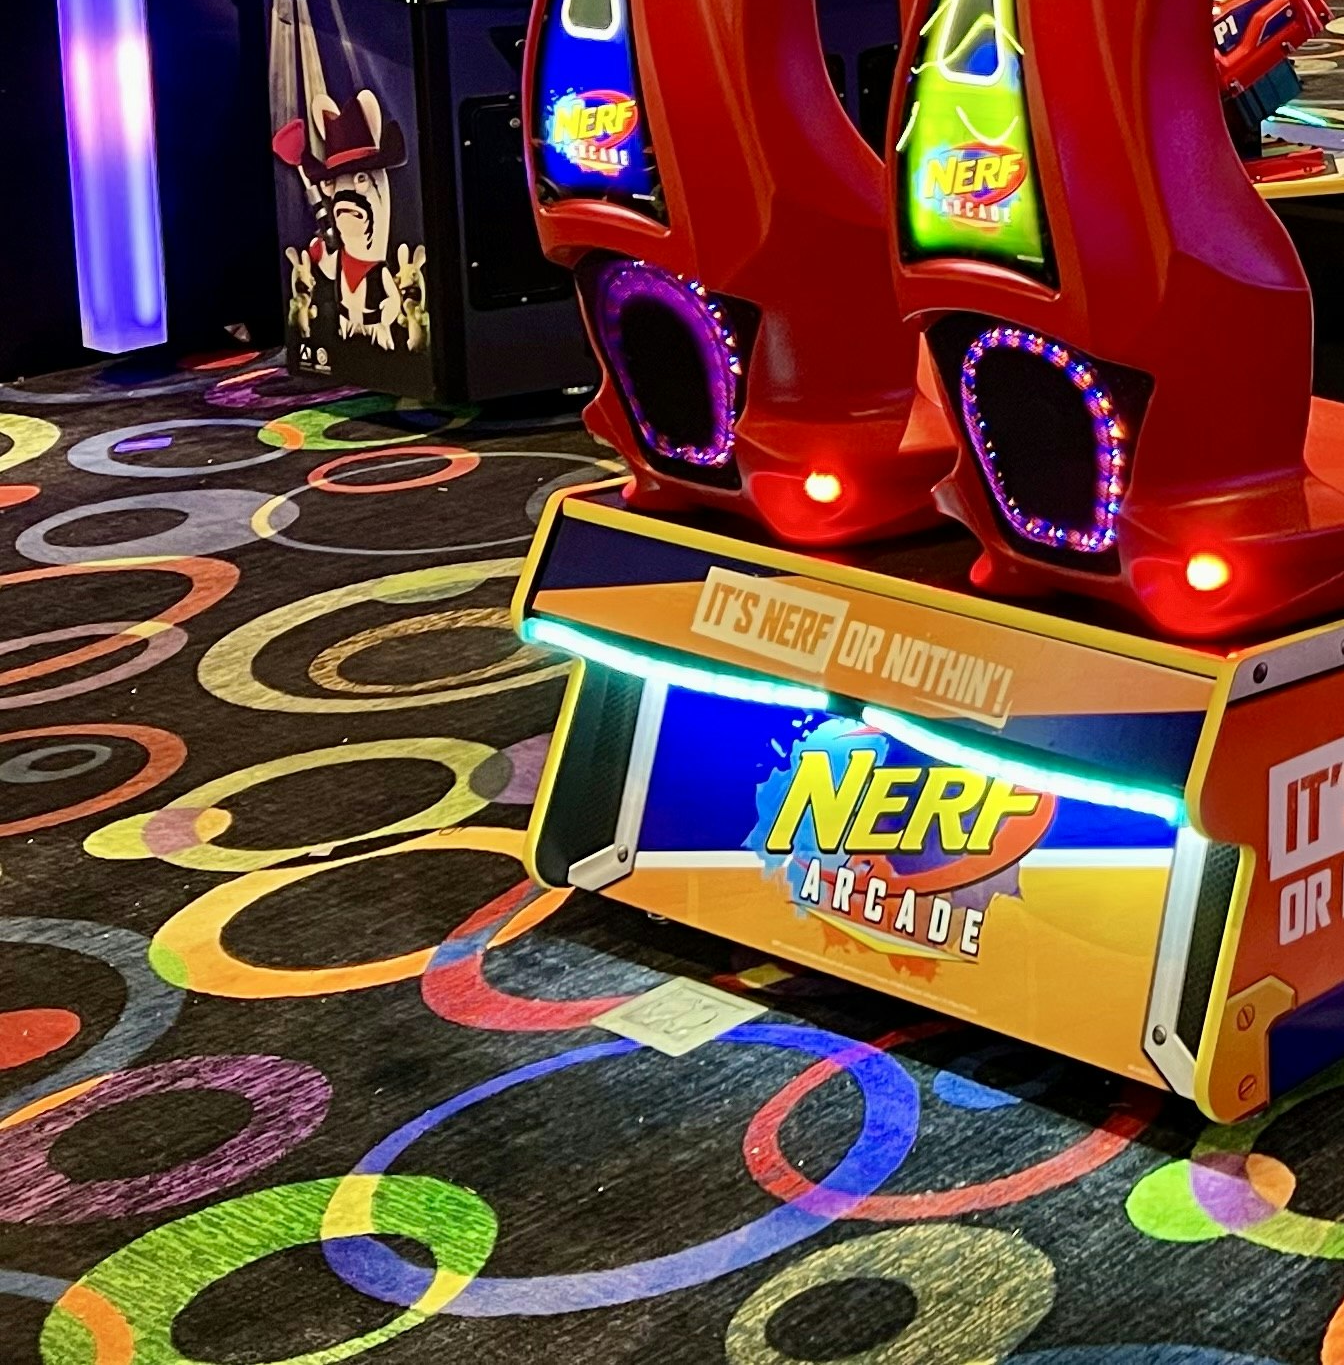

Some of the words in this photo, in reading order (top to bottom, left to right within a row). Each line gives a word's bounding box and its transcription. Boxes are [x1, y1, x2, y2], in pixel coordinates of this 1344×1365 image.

[1215, 15, 1239, 46] P1
[553, 99, 639, 141] NERF
[922, 150, 1024, 200] NERF
[940, 196, 1014, 226] ARCADE
[703, 581, 759, 634] IT'S
[757, 597, 836, 656] NERF
[838, 620, 885, 673] OR
[881, 633, 1014, 715] NOTHIN'!
[766, 748, 1041, 854] NERF
[799, 857, 984, 956] ARCADE
[1279, 867, 1331, 946] OR
